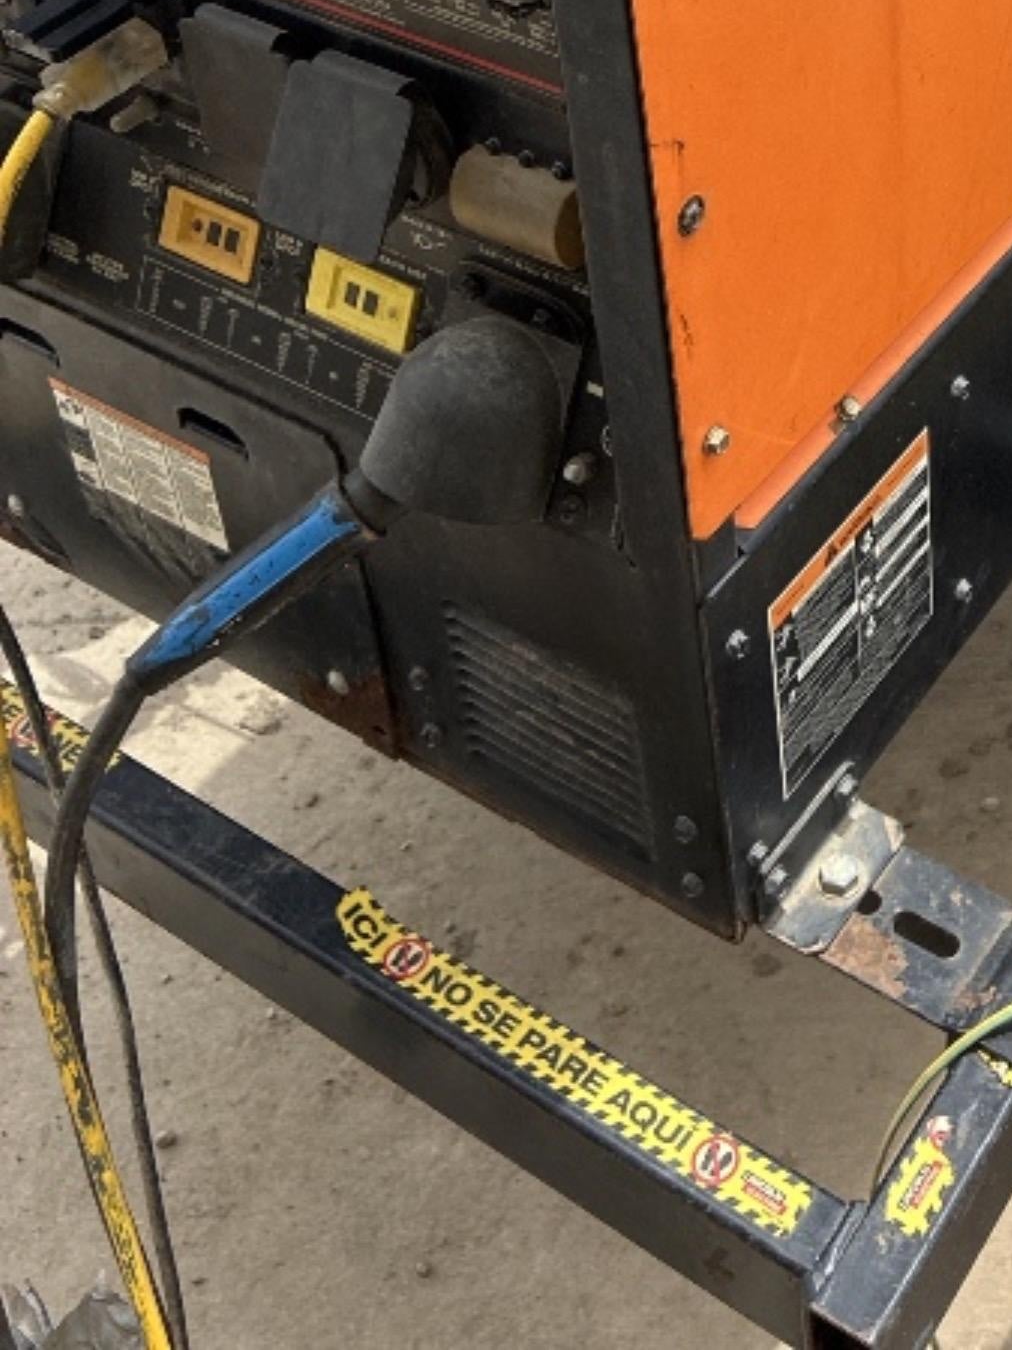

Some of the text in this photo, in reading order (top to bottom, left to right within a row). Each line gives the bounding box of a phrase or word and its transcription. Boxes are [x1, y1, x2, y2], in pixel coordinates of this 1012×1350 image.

[344, 902, 387, 950] ICI
[419, 966, 475, 1008] NO
[472, 995, 523, 1037] SE
[518, 1027, 610, 1098] PARE
